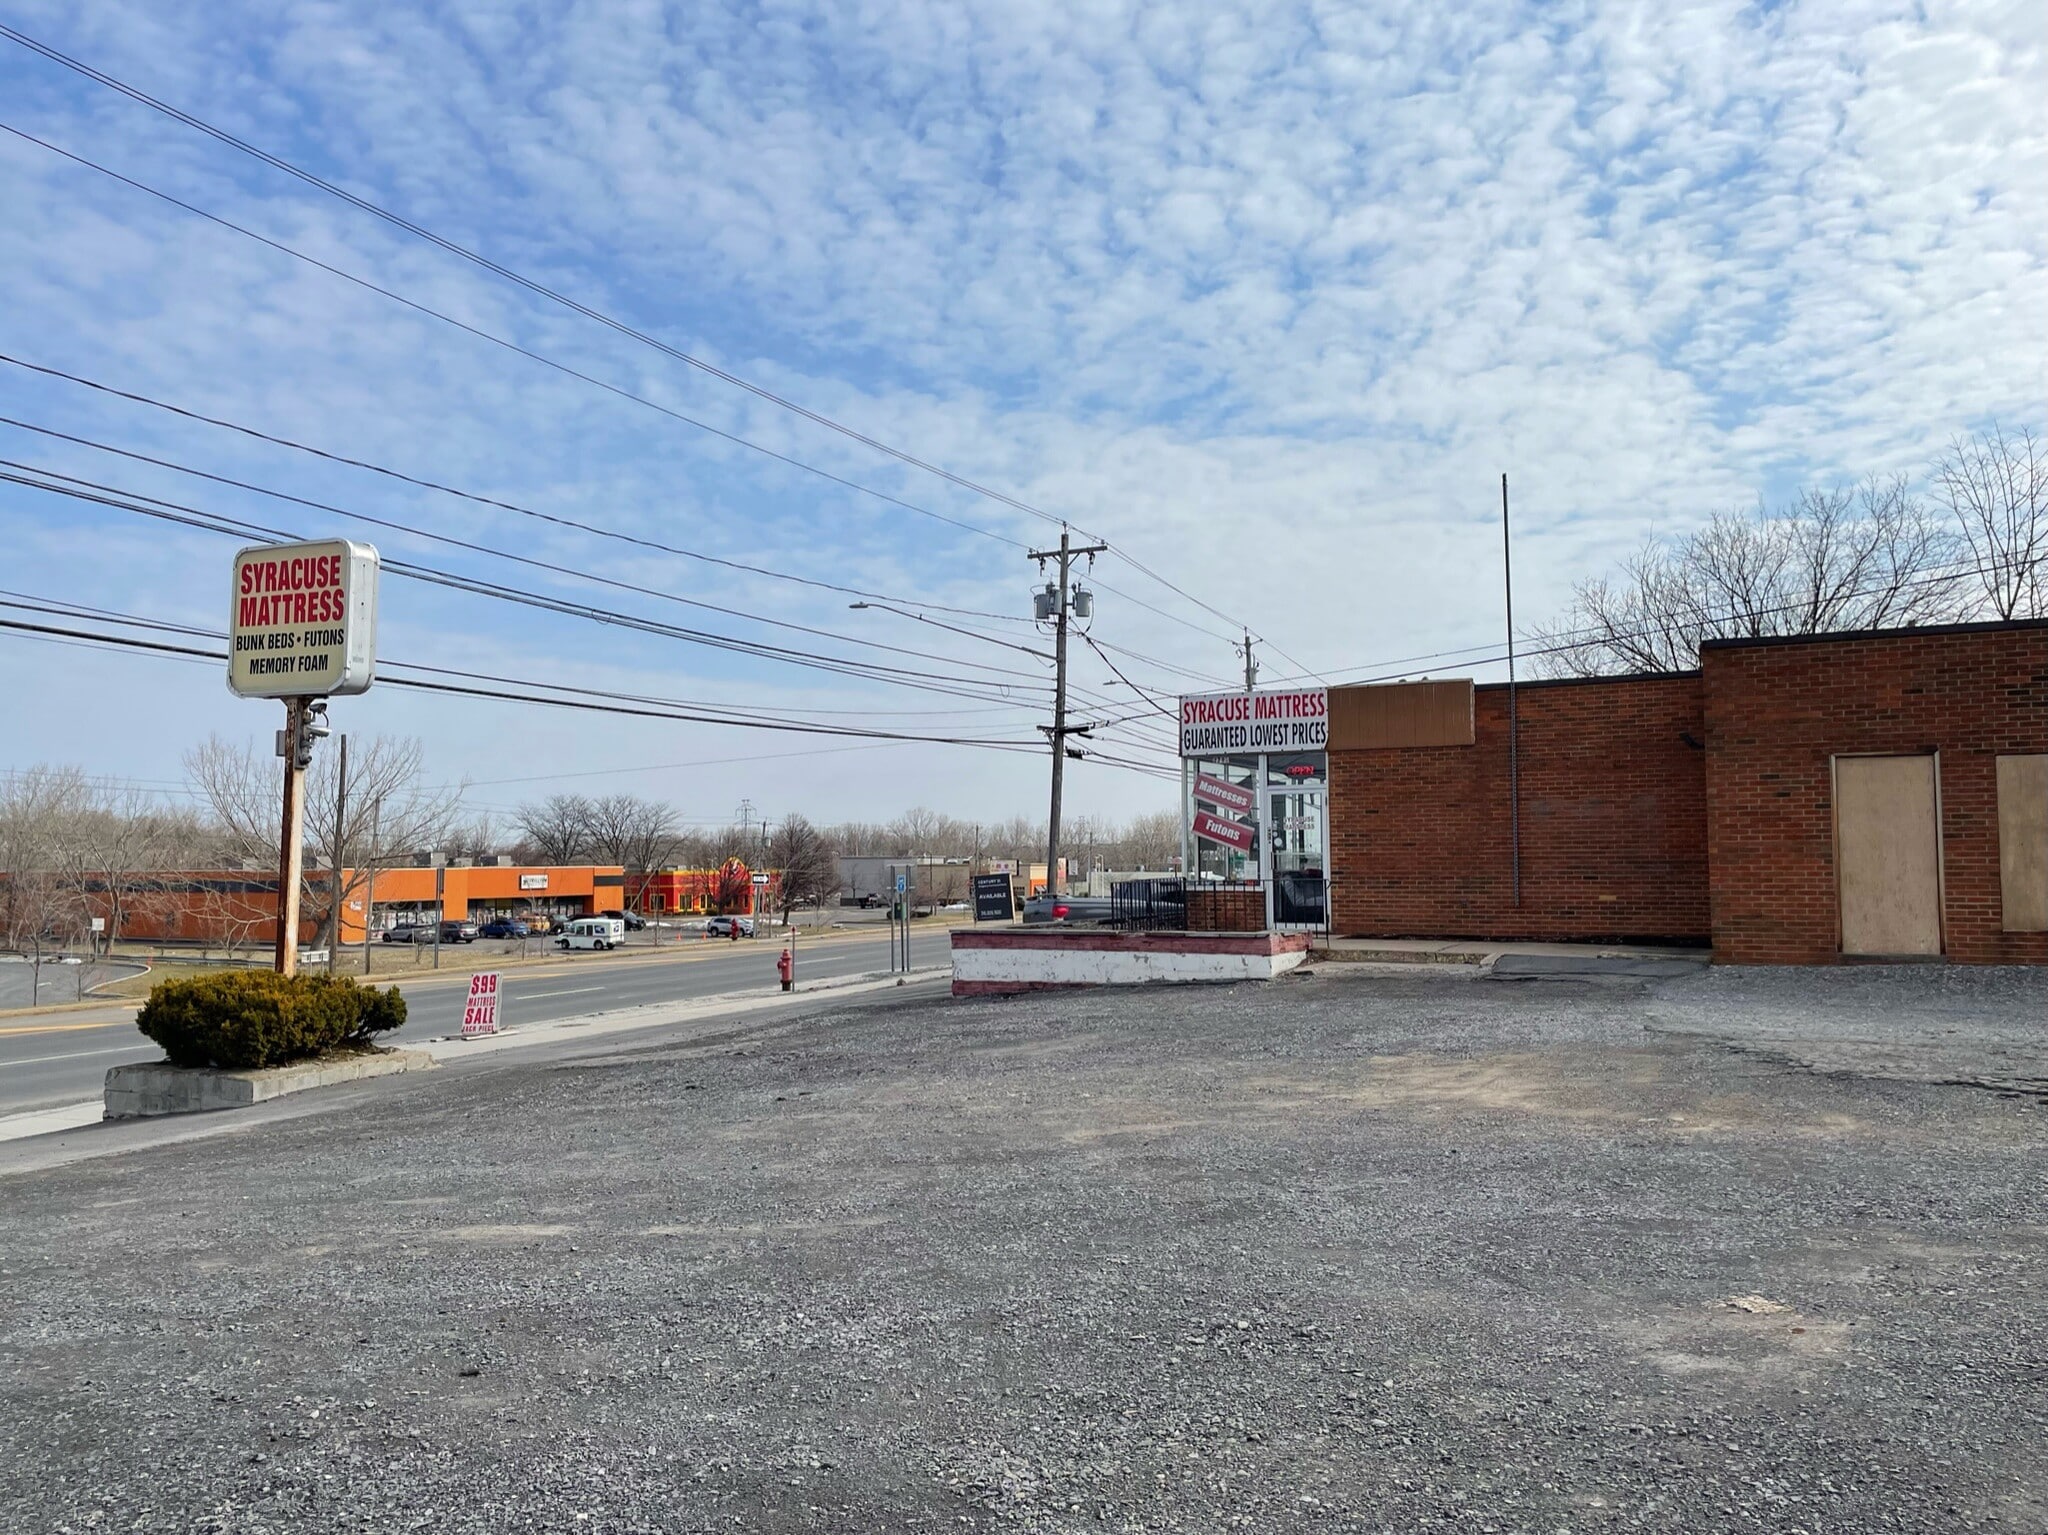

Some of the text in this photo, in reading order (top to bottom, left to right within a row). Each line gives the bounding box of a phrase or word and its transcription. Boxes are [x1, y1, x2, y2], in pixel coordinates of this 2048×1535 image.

[241, 555, 341, 595] SYRACUSE
[239, 589, 344, 627] MATTRESS
[236, 629, 344, 651] BUNK BEDS FUTONS
[249, 654, 329, 674] MEMORY FOAM
[1183, 693, 1325, 724] SYRACUSE MATTRESS
[1184, 721, 1327, 750] GUARANTEED LOWEST PRICES
[1287, 765, 1315, 775] OPEN
[1198, 781, 1248, 807] Mattresses
[1205, 819, 1241, 841] Futons
[472, 974, 496, 995] $99
[467, 996, 496, 1007] MATTRESS
[465, 1007, 494, 1024] SALE
